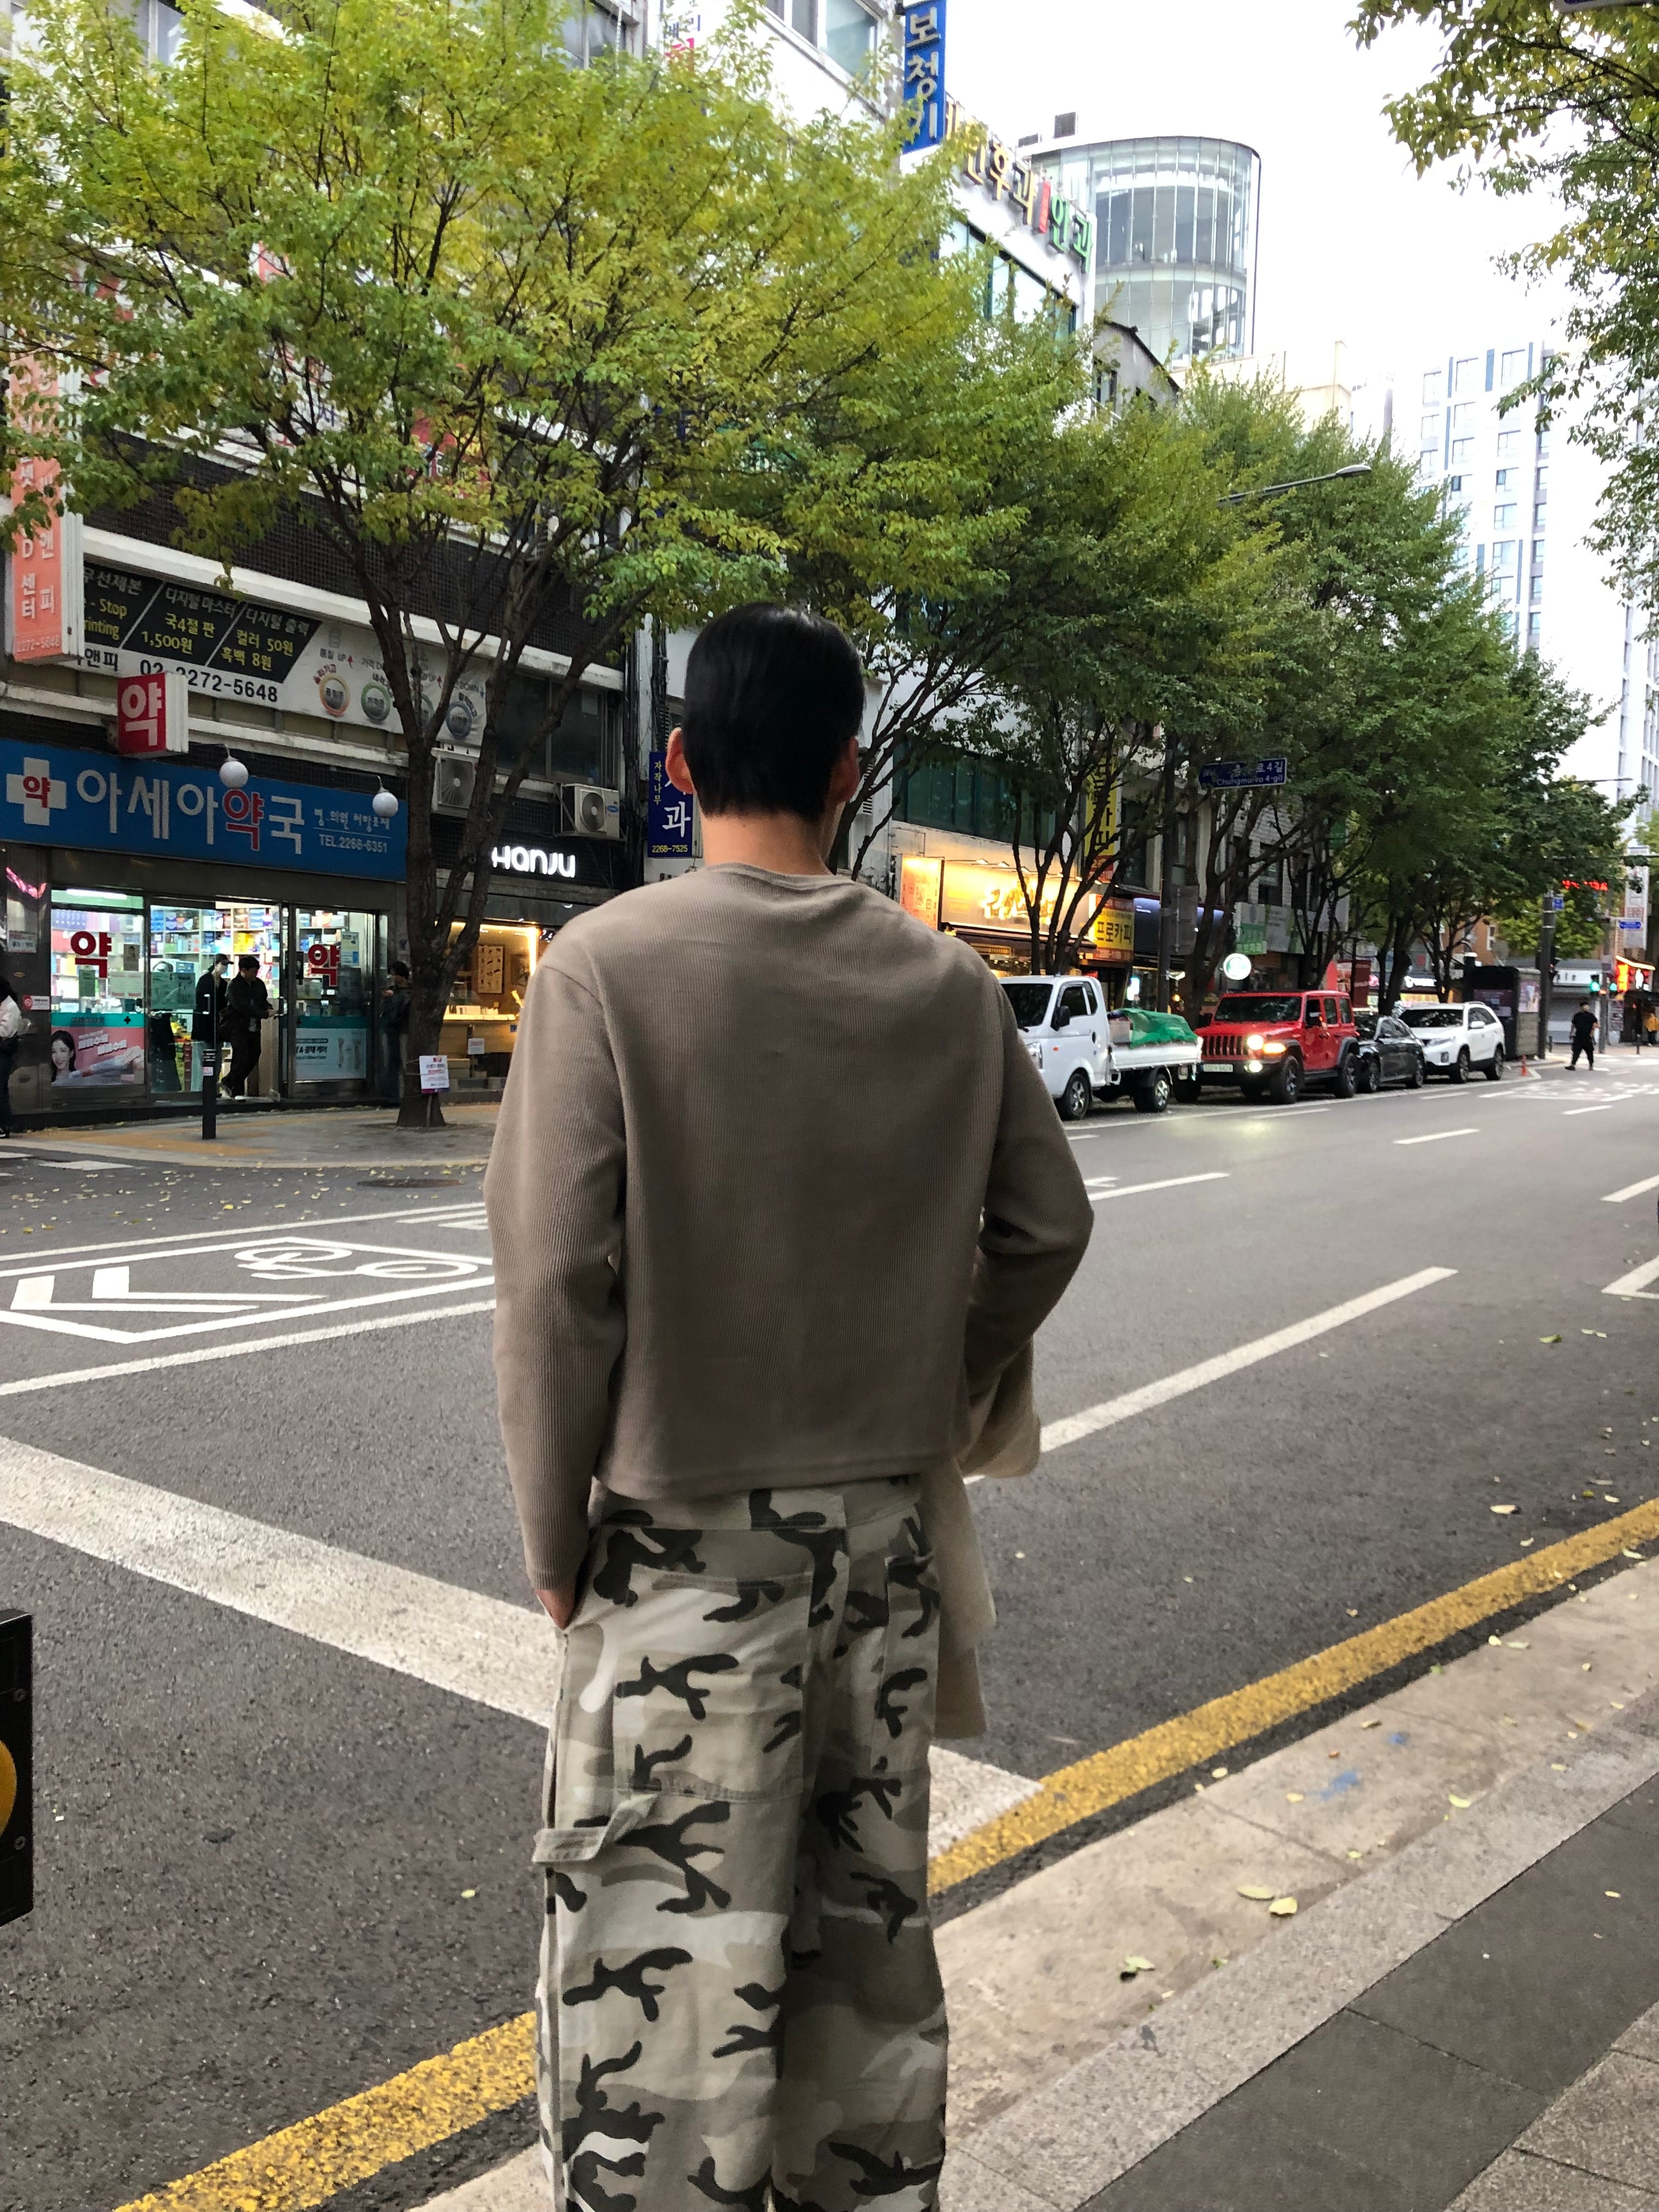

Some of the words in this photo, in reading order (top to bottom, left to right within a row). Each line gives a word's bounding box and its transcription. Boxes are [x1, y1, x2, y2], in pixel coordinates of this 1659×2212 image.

[906, 7, 941, 138] 보청기
[1051, 194, 1093, 274] 안과
[99, 598, 127, 619] Stop
[165, 588, 200, 610] 디지털
[84, 617, 120, 640] rinting
[246, 608, 282, 630] 디지털
[141, 631, 193, 654] 1,500원
[237, 629, 260, 648] 컬러
[267, 638, 294, 657] 50원
[77, 648, 119, 672] 앤피
[221, 646, 245, 666] 흑백
[252, 653, 273, 672] 8원
[121, 682, 162, 746] 약
[1265, 774, 1283, 783] 4-gil
[23, 776, 51, 809] 약
[77, 769, 305, 855] 아세아약국
[662, 780, 691, 838] 과
[652, 844, 689, 854] 2268-7525
[1096, 921, 1132, 945] 프로카피
[71, 931, 112, 978] 약
[308, 944, 340, 987] 약
